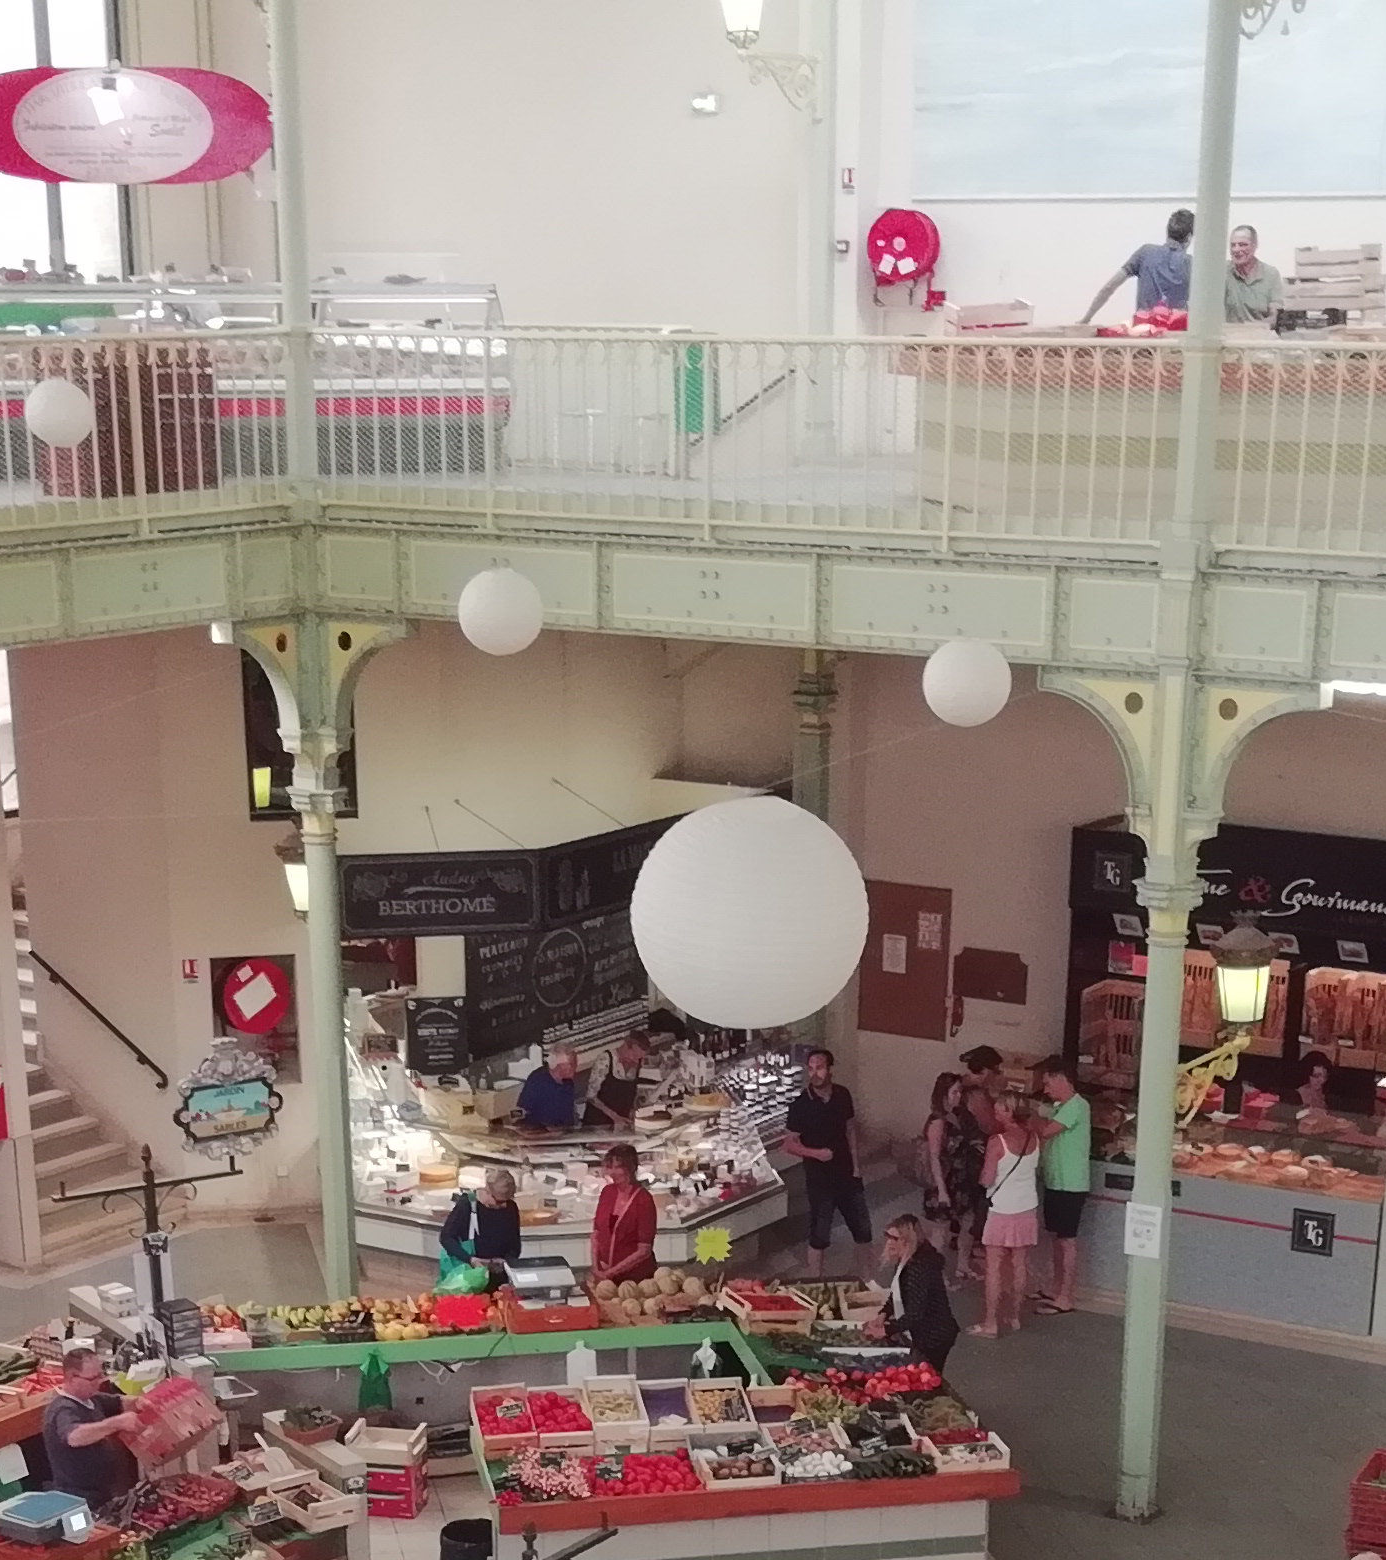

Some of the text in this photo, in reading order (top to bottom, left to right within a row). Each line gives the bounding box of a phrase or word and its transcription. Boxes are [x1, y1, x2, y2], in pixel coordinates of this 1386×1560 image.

[1237, 875, 1273, 904] &
[377, 895, 497, 918] BERTHOMÉ
[213, 1085, 246, 1099] JARDIN
[213, 1119, 249, 1134] SABLES
